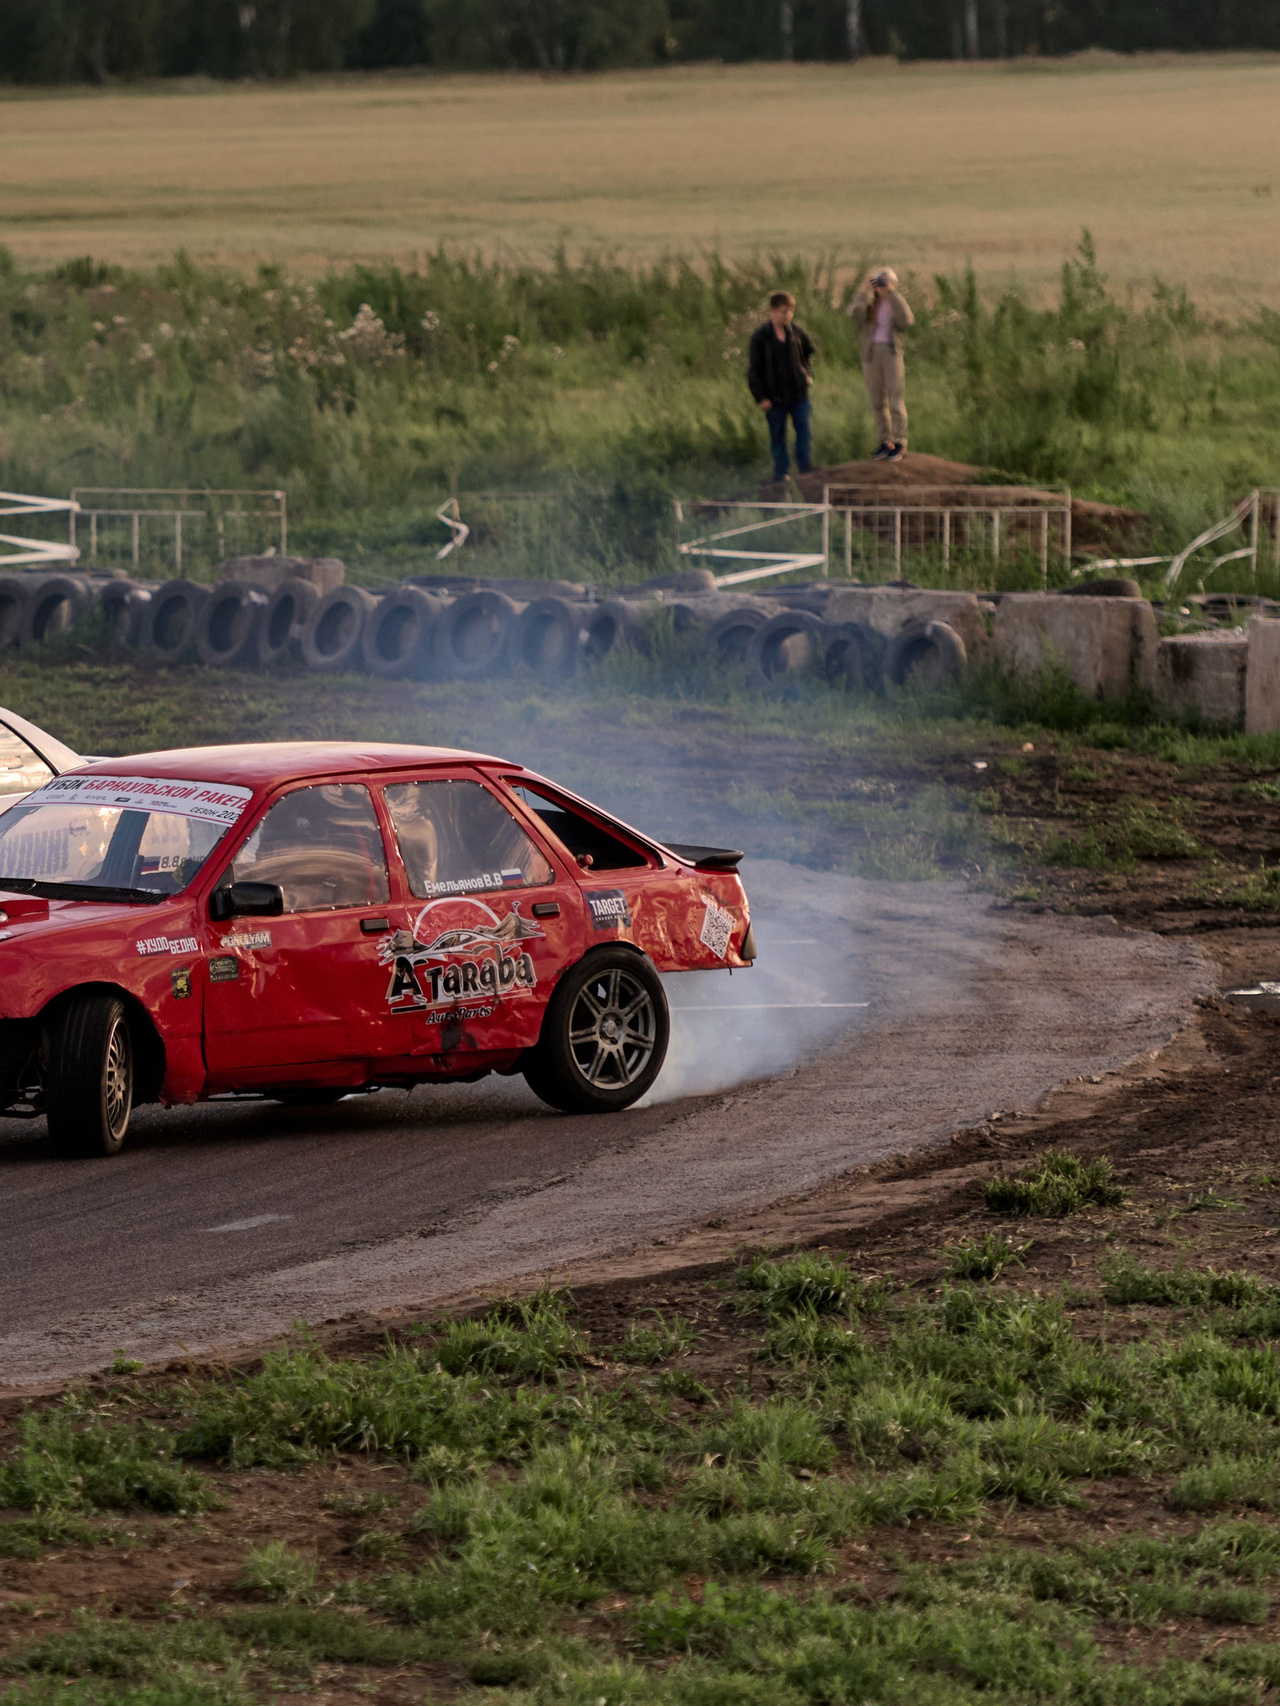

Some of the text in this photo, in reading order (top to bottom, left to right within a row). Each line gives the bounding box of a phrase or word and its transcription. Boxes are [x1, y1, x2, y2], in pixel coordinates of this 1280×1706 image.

[83, 780, 197, 799] БАРНАУЛЬСКОЙ
[190, 806, 241, 821] СЕЗОН 202
[424, 878, 483, 893] Емельянов
[589, 898, 626, 916] TARGET
